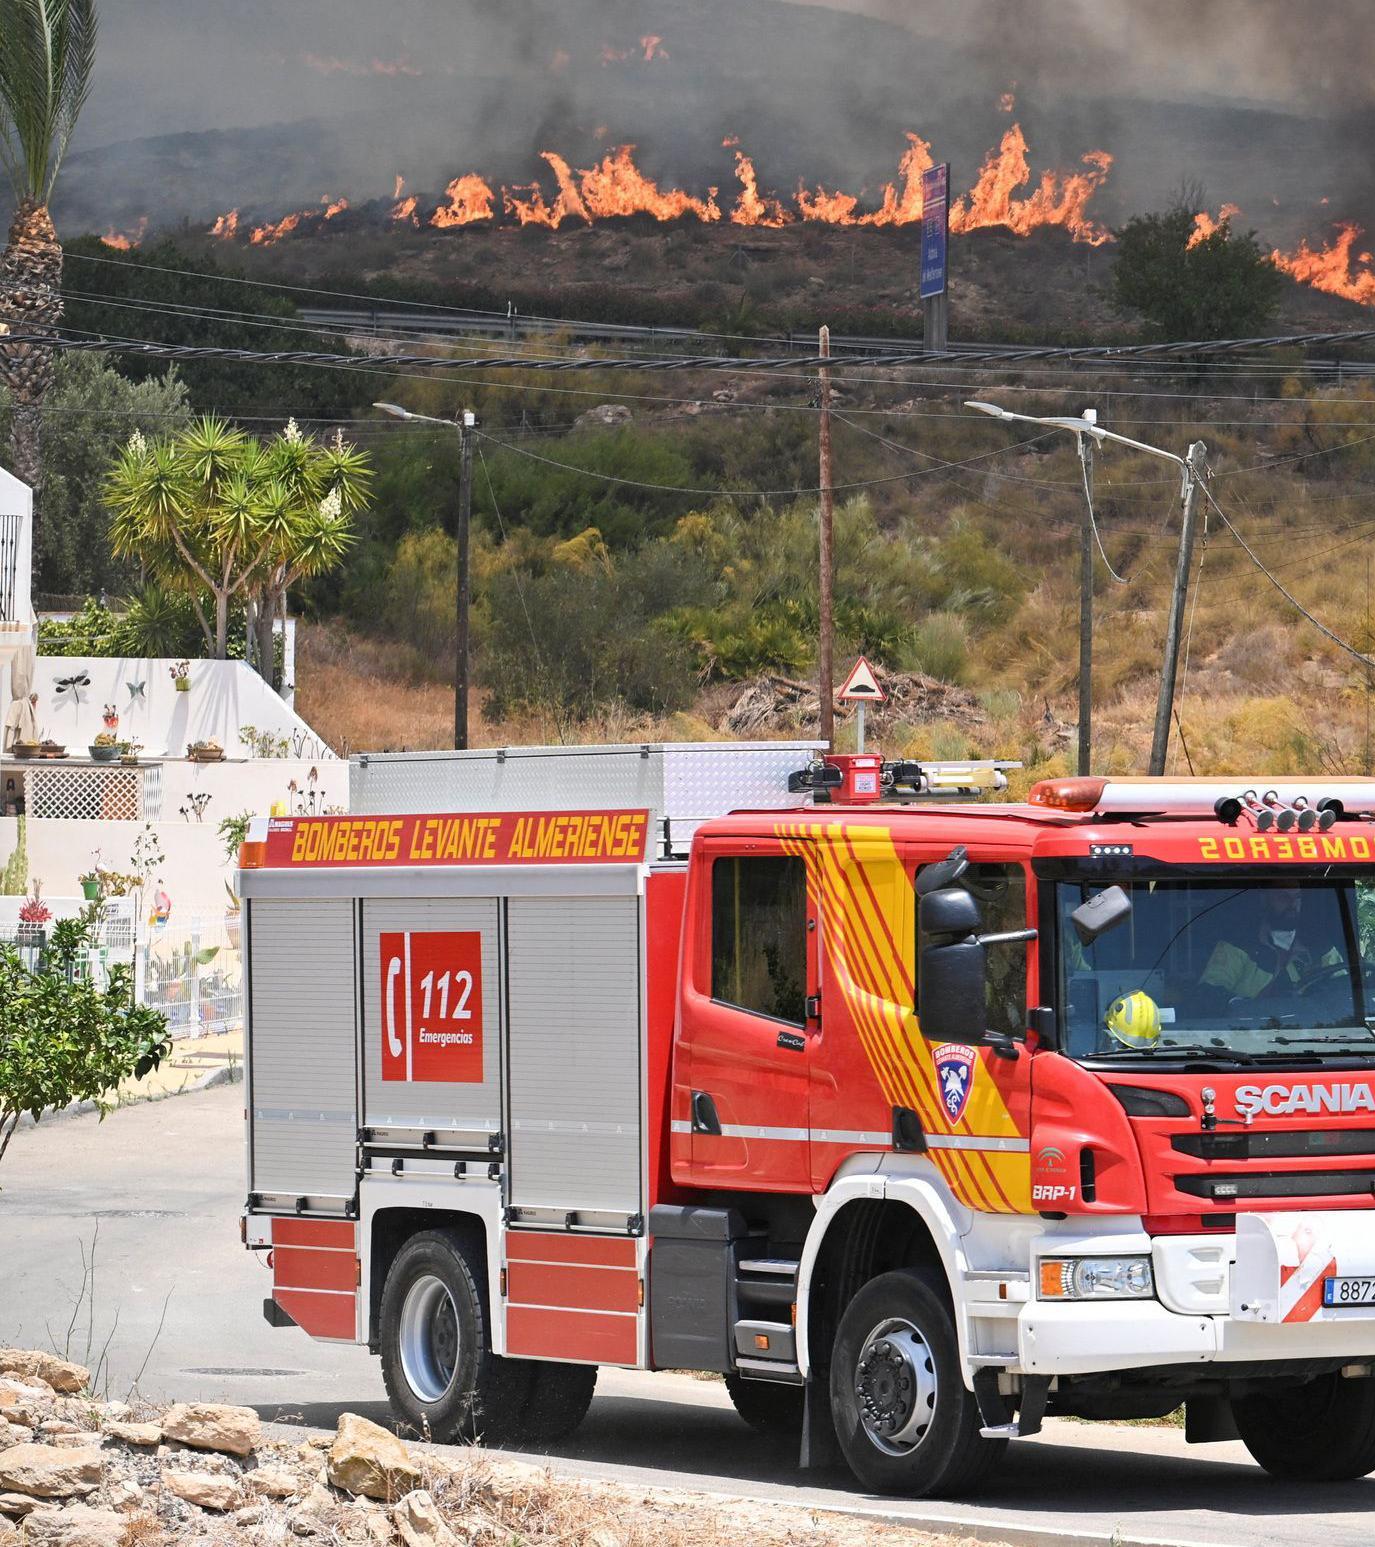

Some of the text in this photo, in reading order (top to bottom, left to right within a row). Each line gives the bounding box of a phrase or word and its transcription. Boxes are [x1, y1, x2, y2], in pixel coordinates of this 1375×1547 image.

[292, 814, 645, 861] BOMBEROS LEVANTE ALMERIENSE
[420, 970, 473, 1019] 112
[418, 1027, 473, 1048] Emergencias
[935, 1045, 975, 1060] BOMBEROS
